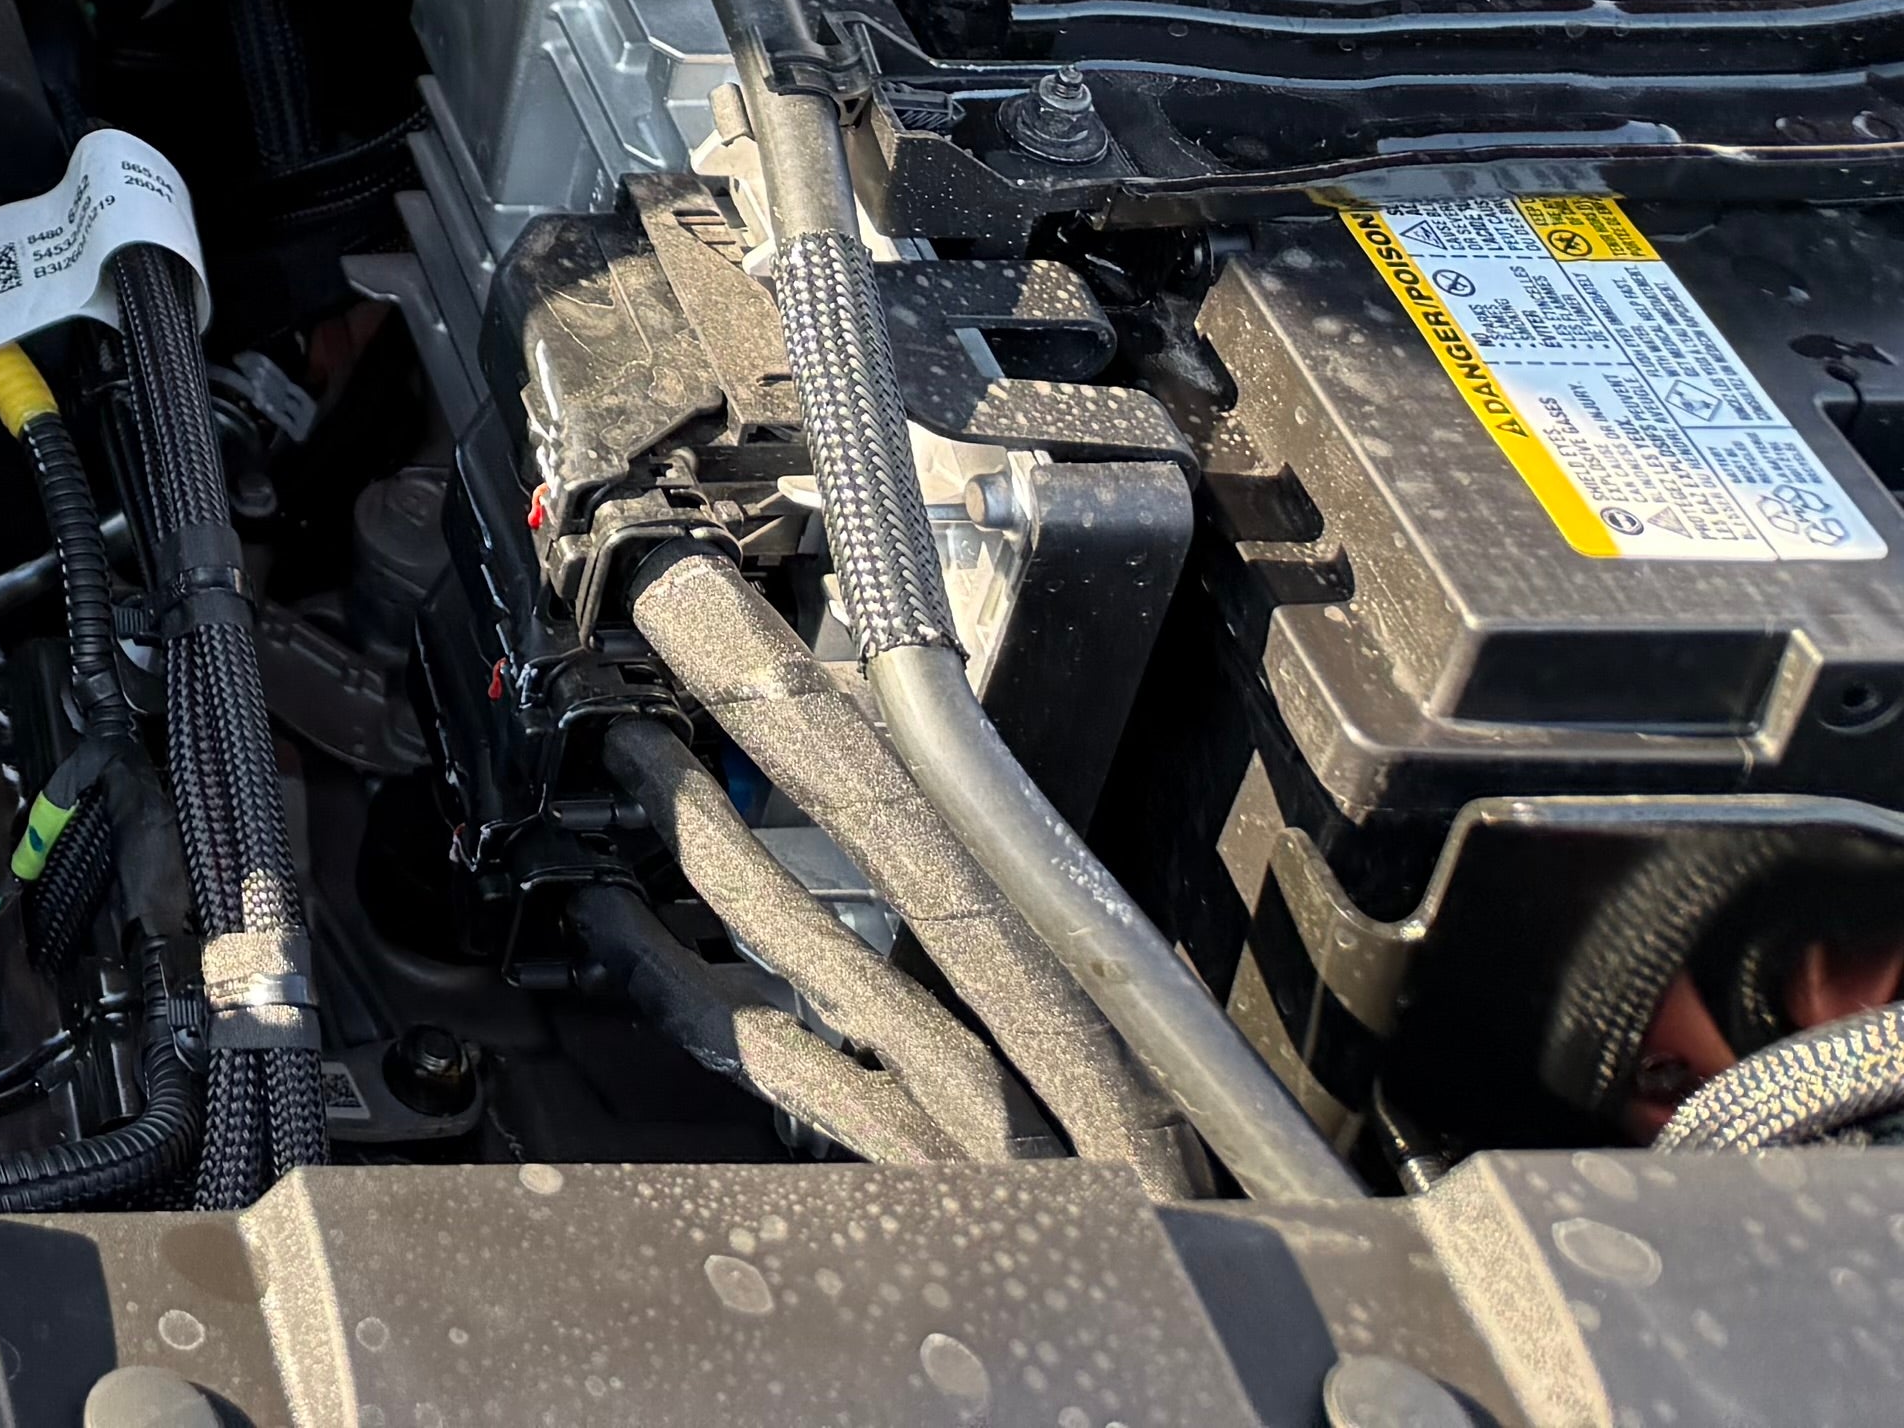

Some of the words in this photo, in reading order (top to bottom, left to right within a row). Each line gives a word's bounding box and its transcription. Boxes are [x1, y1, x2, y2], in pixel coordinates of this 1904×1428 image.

[27, 226, 63, 244] 8480
[1433, 220, 1466, 250] CAUSE
[1463, 213, 1505, 250] L'ACIDE
[1495, 226, 1524, 250] PEUT
[1506, 218, 1529, 234] DES
[1509, 265, 1562, 321] ÉTINCELLES
[1533, 275, 1577, 320] FLAMMES
[1573, 272, 1624, 325] IMMEDIATELY
[1352, 213, 1512, 413] DANGER/POISON
[1469, 304, 1505, 340] SPARKS
[1485, 304, 1521, 340] FLAMES
[1495, 298, 1537, 340] SMOKING
[1562, 294, 1597, 326] FUMER
[1630, 300, 1657, 320] HELP
[1472, 333, 1495, 346] NO
[1518, 310, 1563, 347] ÉVITER
[1553, 324, 1576, 340] LES
[1569, 324, 1593, 341] LES
[1589, 329, 1609, 341] DE
[1615, 327, 1641, 347] EYES
[1648, 324, 1686, 358] MEDICAL
[1631, 349, 1663, 377] FLUSH
[1653, 354, 1681, 376] WITH
[1677, 361, 1700, 376] GET
[1567, 380, 1608, 421] INJURY.
[1603, 373, 1650, 420] PEUVENT
[1539, 397, 1579, 433] GASES
[1600, 425, 1620, 438] OR
[1613, 415, 1651, 448] YEUX.
[1595, 443, 1630, 476] CAUSE
[1640, 424, 1700, 487] EXPLOSIFS
[1642, 454, 1669, 473] LES
[1660, 427, 1704, 469] RENDRE
[1569, 461, 1610, 500] SHIELD
[1571, 438, 1629, 501] EXPLOSIVE
[1613, 442, 1668, 502] BLINDNESS
[1696, 473, 1718, 487] OU
[1623, 481, 1649, 502] CAN
[1690, 492, 1719, 514] GAZ
[1657, 478, 1718, 539] PROTÉGEZ
[1710, 519, 1738, 540] LES
